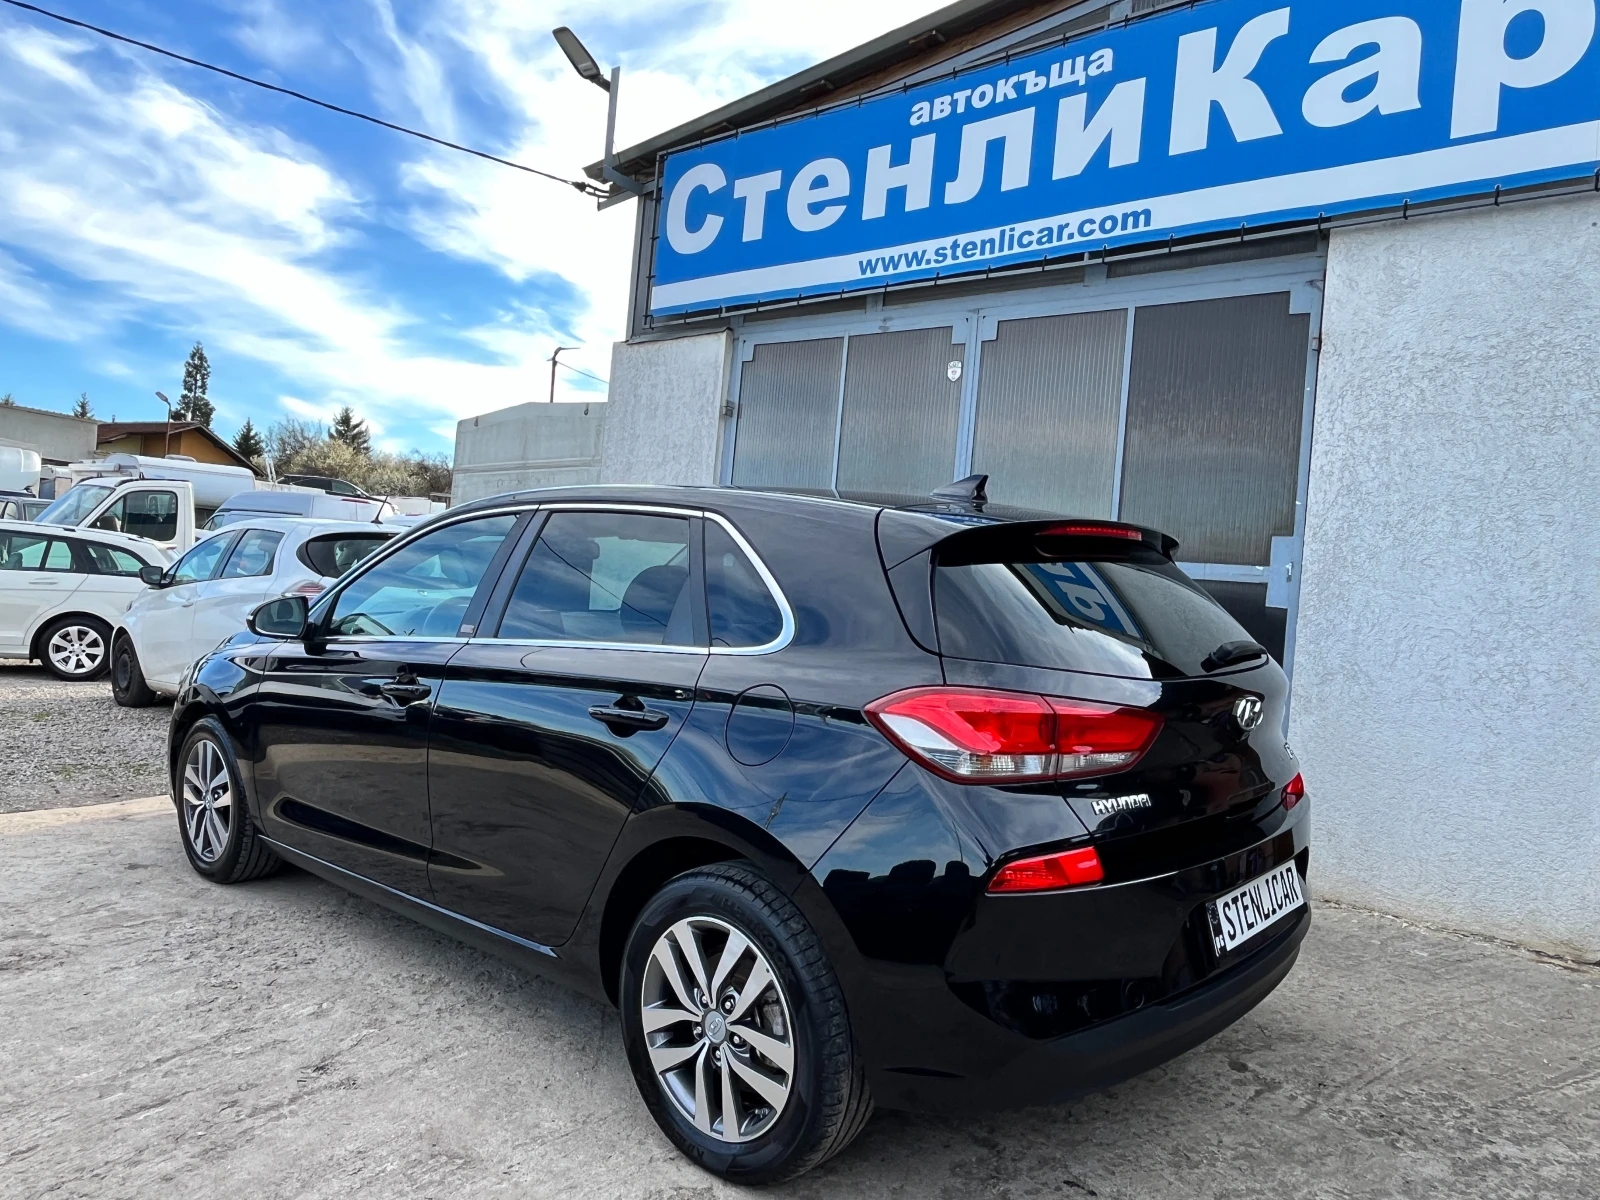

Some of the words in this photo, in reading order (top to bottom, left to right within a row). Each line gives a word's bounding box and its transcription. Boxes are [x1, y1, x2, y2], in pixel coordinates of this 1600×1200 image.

[909, 47, 1114, 126] автокъща
[858, 207, 1153, 277] www.stenlicar.com
[1091, 793, 1152, 815] HYUNDAI
[1222, 866, 1299, 942] STENLICAR
